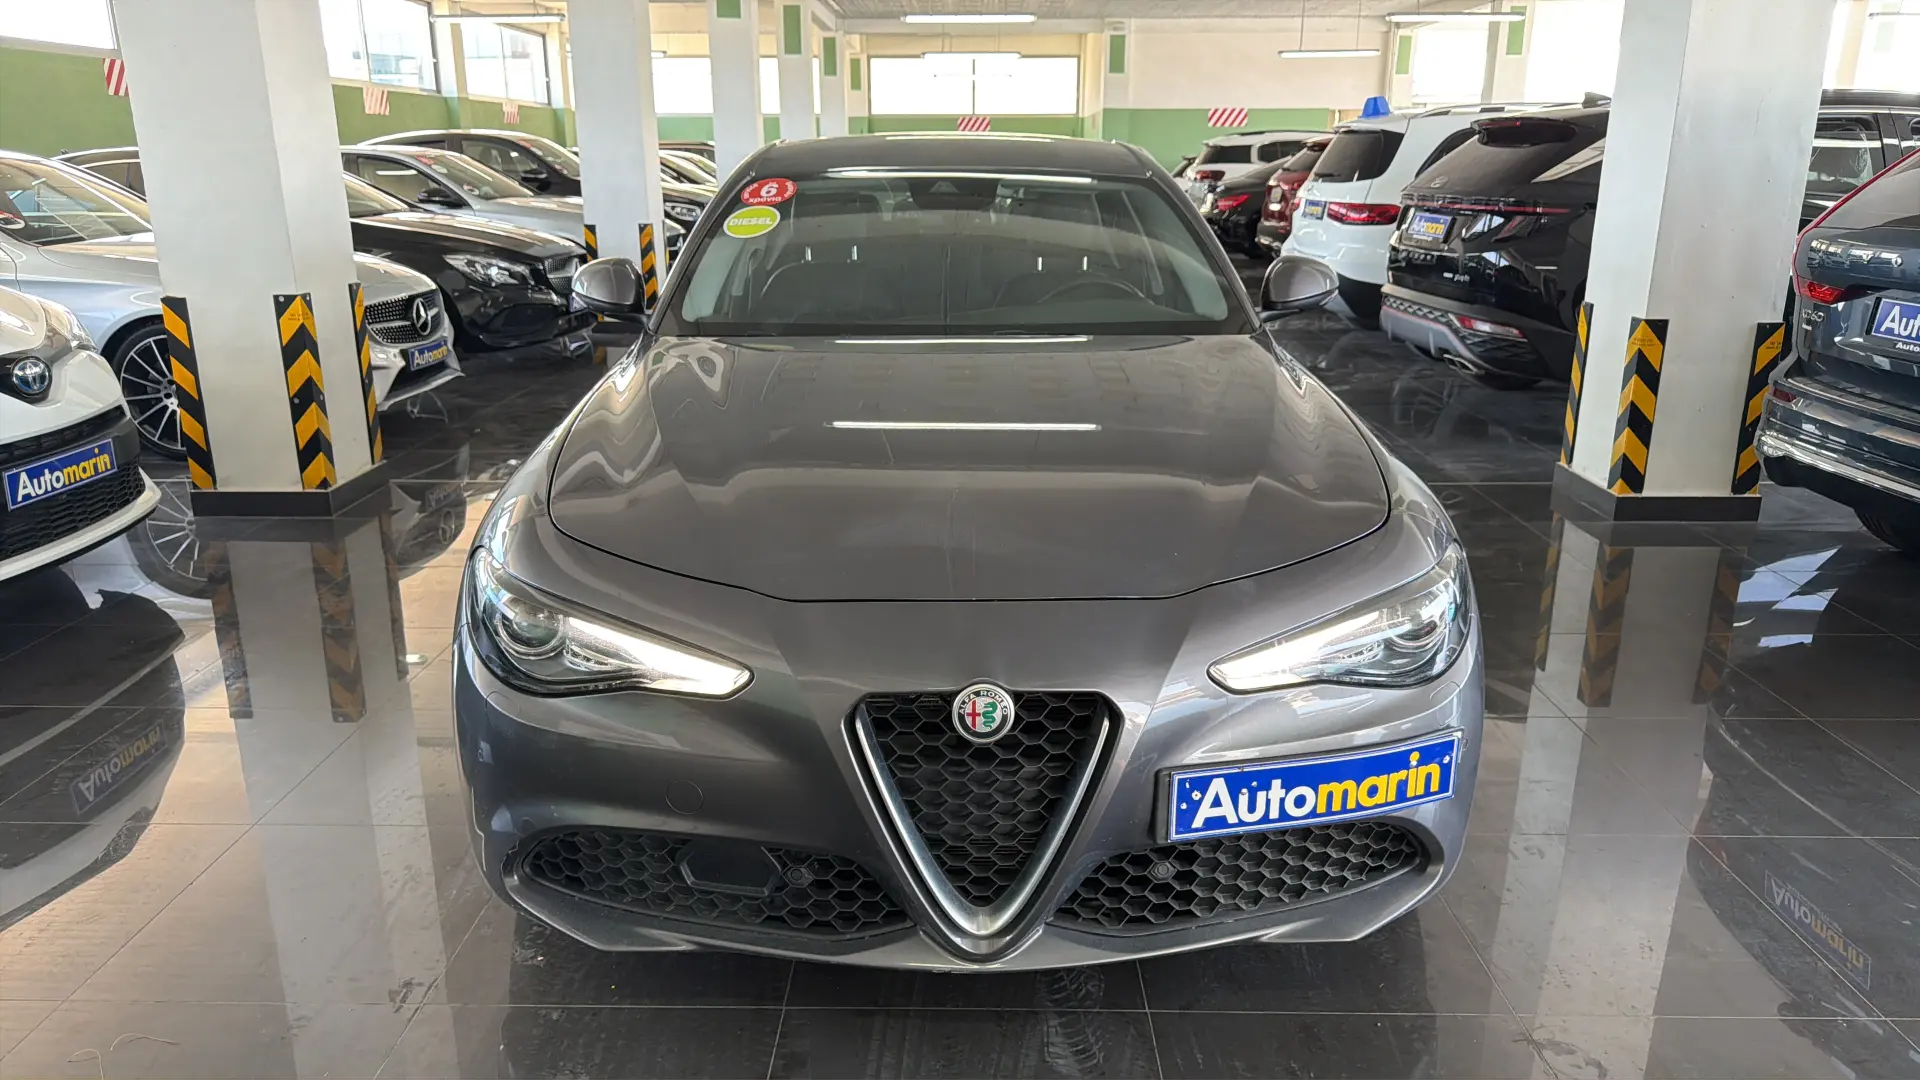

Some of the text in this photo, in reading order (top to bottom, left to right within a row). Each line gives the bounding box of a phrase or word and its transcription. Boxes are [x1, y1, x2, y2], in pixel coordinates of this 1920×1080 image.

[760, 183, 780, 197] 6
[729, 217, 773, 226] DIESEL
[1879, 305, 1920, 338] Aut
[17, 447, 111, 502] Automarin
[959, 690, 1008, 715] ALFA ROMEO
[1191, 751, 1441, 829] Automarin
